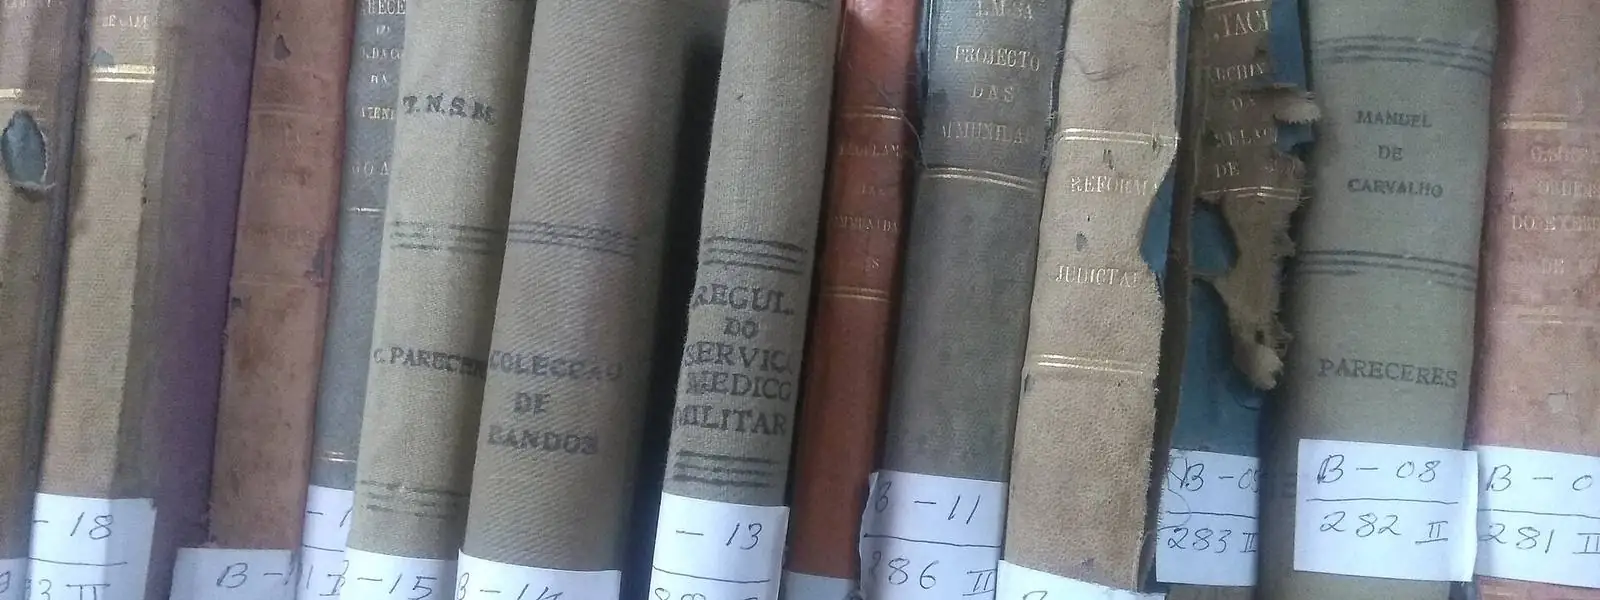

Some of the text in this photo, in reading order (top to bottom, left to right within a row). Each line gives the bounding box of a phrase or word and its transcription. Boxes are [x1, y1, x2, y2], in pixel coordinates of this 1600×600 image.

[1354, 109, 1433, 129] MANUEL
[1377, 144, 1404, 162] DE
[1347, 177, 1444, 199] CARVALHO
[723, 316, 759, 339] DO
[1316, 357, 1459, 390] PARECERES
[512, 391, 551, 417] DE
[1316, 453, 1346, 485] B
[1395, 459, 1442, 484] 08
[1485, 463, 1513, 492] B
[724, 522, 763, 550] 13
[1318, 510, 1402, 538] 282
[1166, 526, 1233, 554] 283
[1478, 522, 1555, 555] 281
